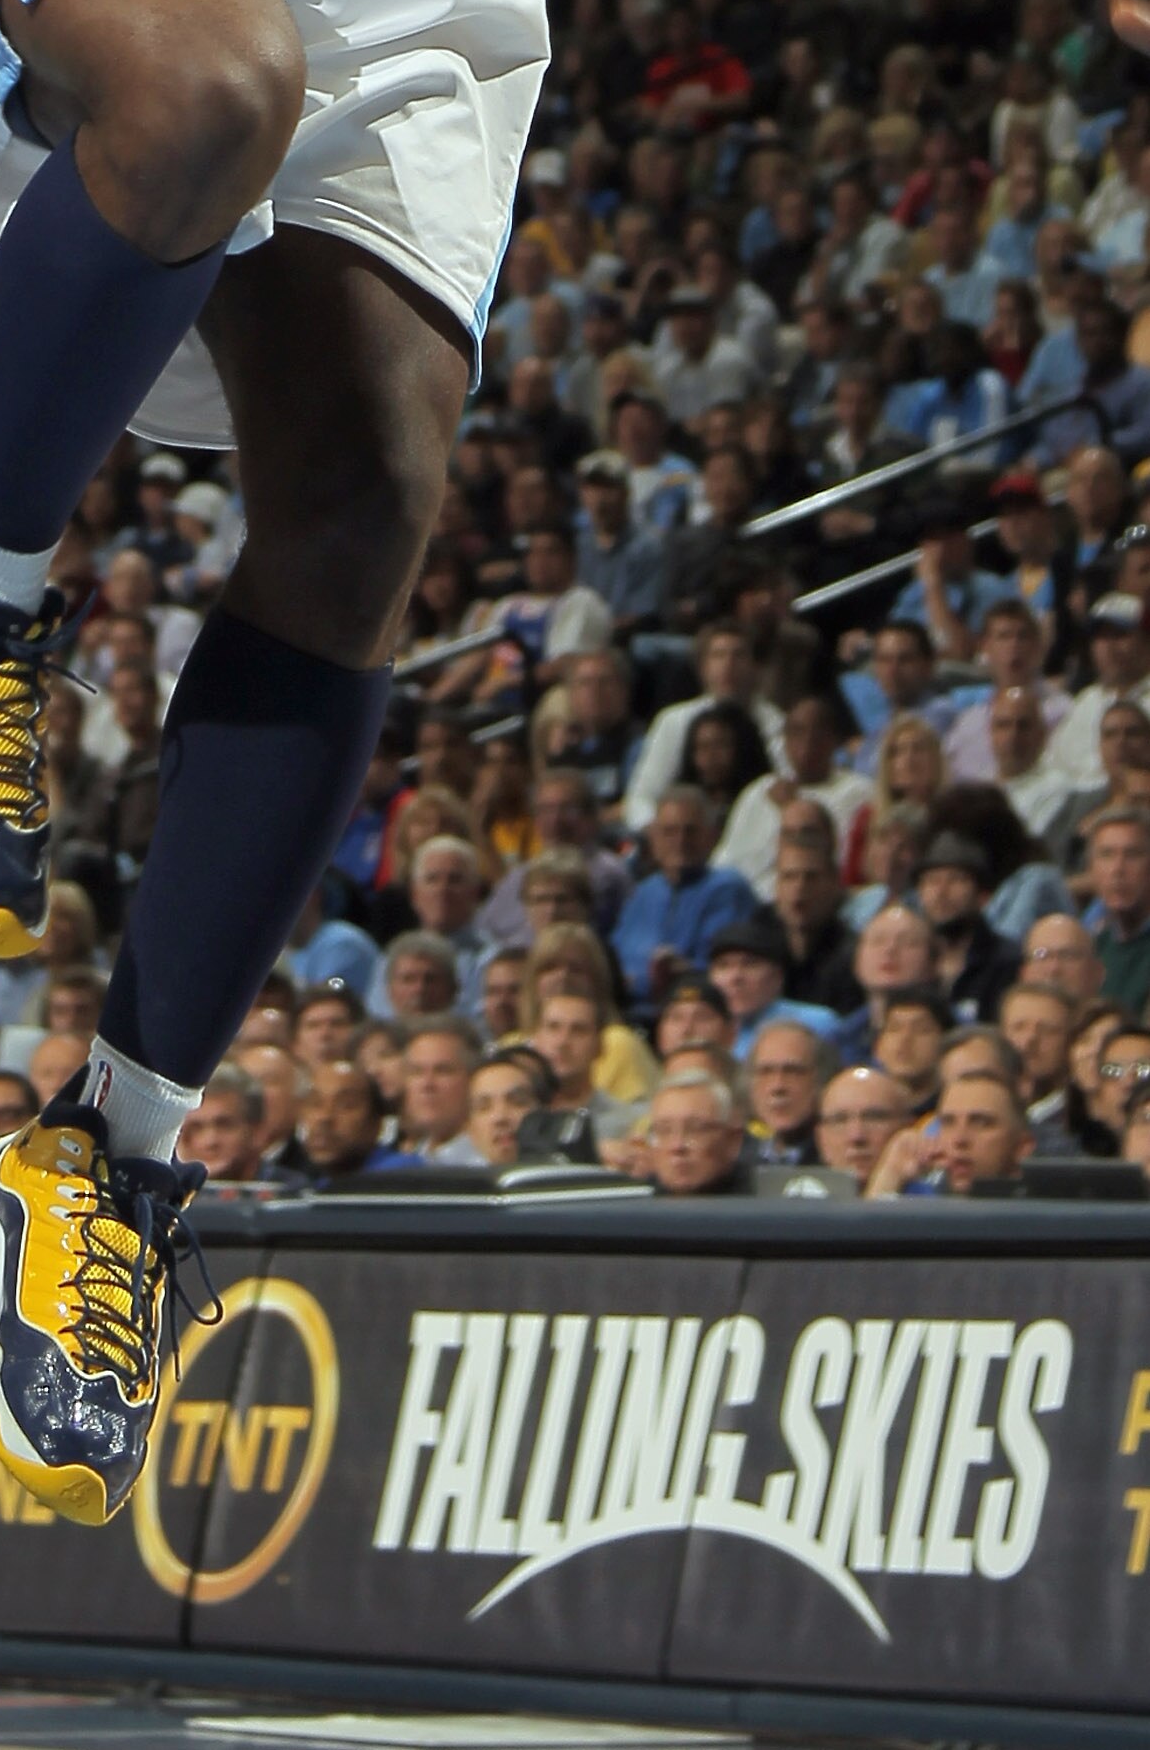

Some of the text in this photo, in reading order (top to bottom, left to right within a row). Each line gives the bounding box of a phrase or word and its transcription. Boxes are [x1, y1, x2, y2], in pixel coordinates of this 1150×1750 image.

[167, 1400, 313, 1494] TNT
[372, 1311, 1074, 1580] FALLING SKIES
